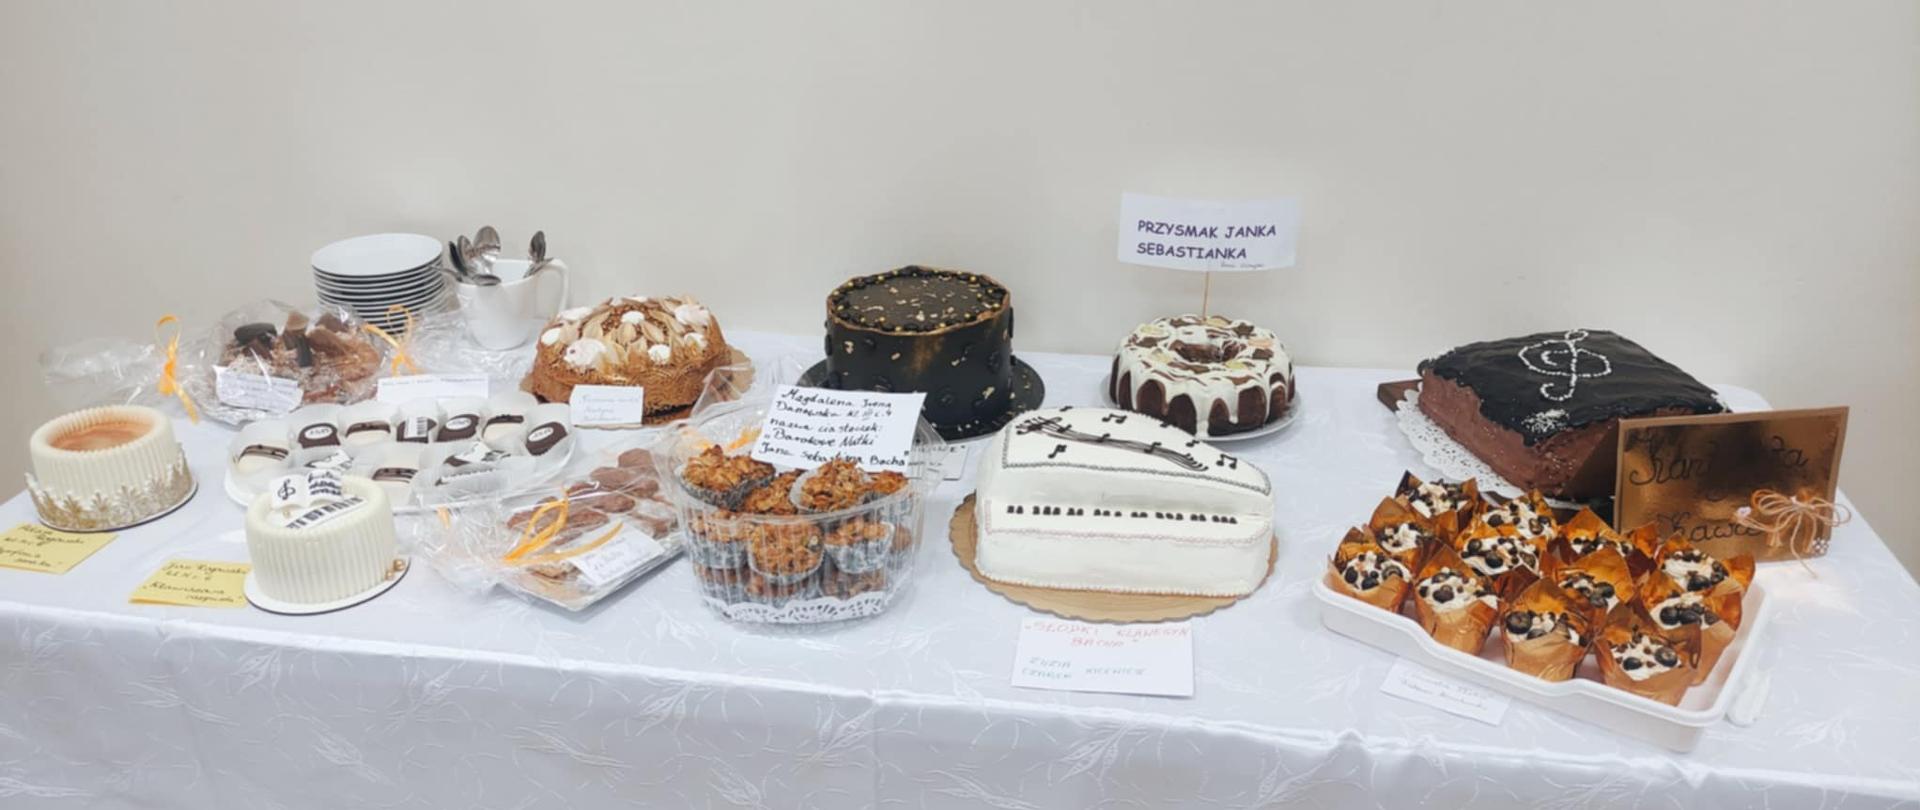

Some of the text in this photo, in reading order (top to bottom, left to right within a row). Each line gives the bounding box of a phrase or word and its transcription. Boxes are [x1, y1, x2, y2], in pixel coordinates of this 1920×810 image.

[1137, 219, 1277, 239] PRZYSMAK JANKA
[1136, 242, 1247, 260] SEBASTIANKA
